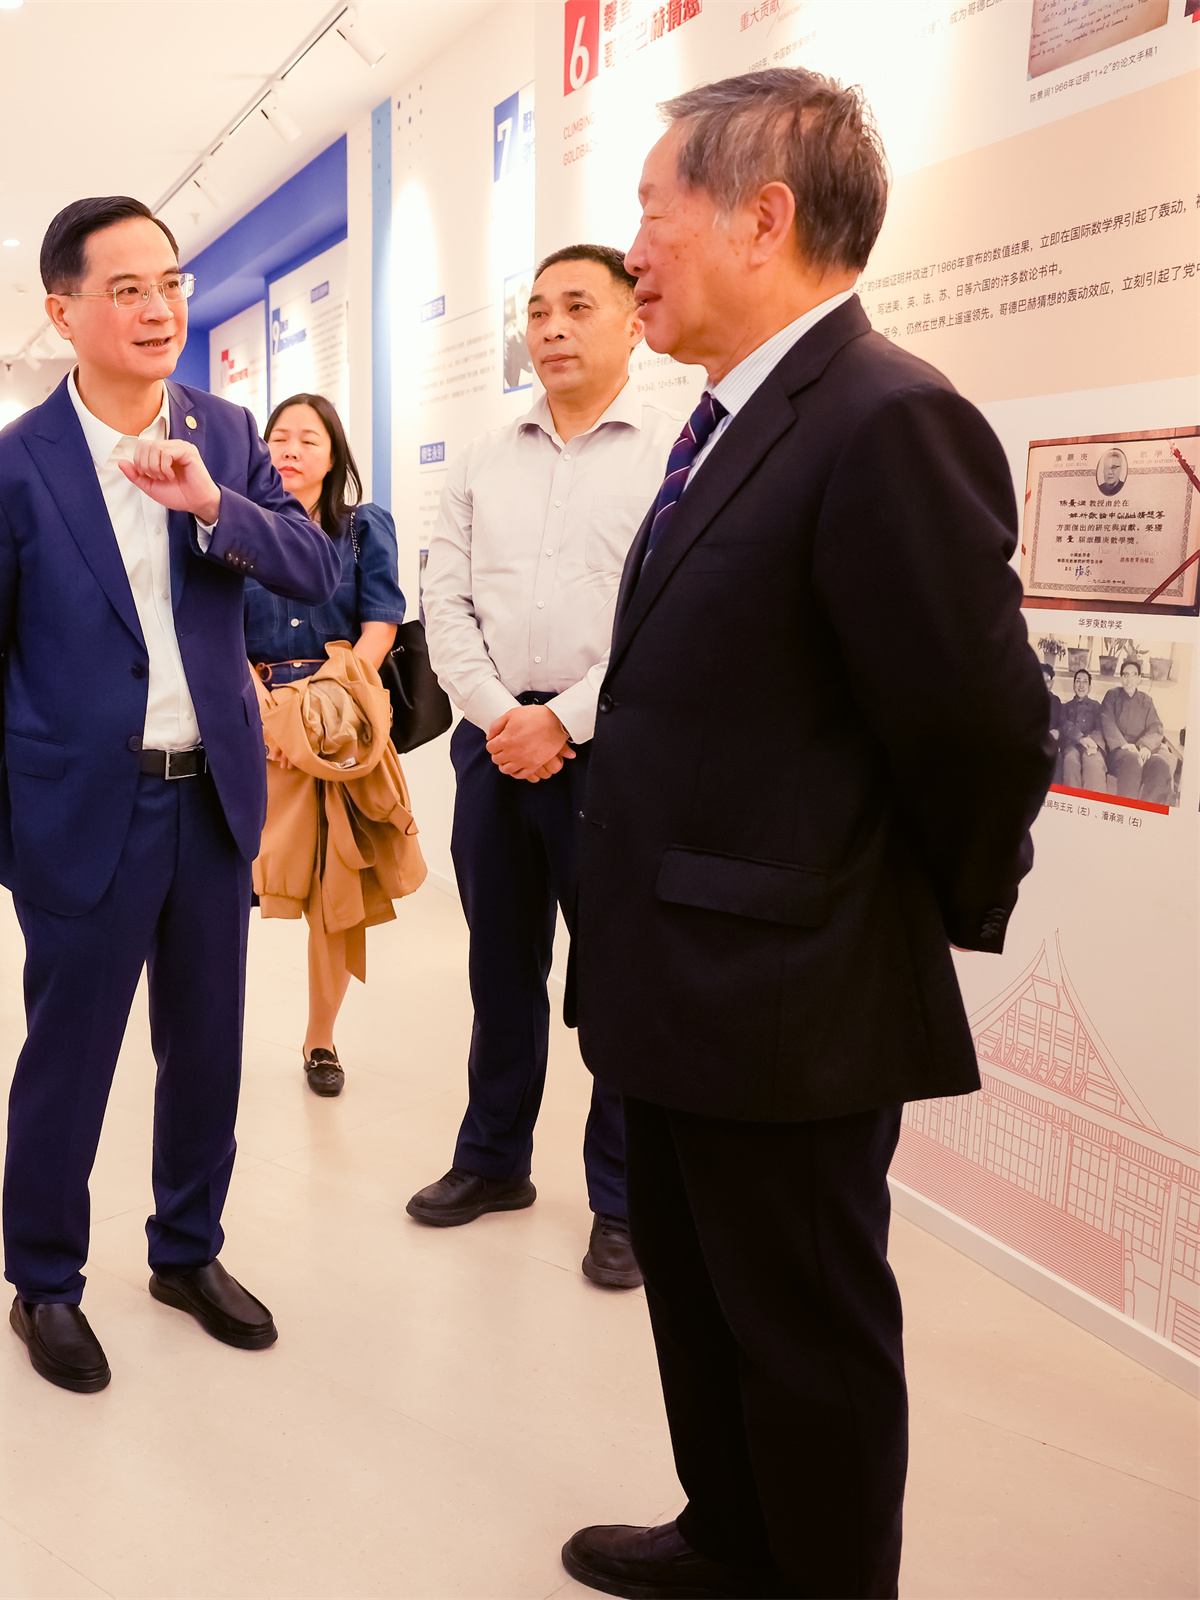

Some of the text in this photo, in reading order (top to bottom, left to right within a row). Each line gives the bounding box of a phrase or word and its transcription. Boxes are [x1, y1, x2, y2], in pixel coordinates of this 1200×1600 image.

[739, 0, 781, 32] 重大贡献
[569, 16, 590, 90] 6
[497, 117, 513, 181] 7
[864, 262, 1064, 317] ”，写进美、英、法、苏、日等六国的许多数论书中。
[1078, 618, 1123, 630] 华罗庚数学奖
